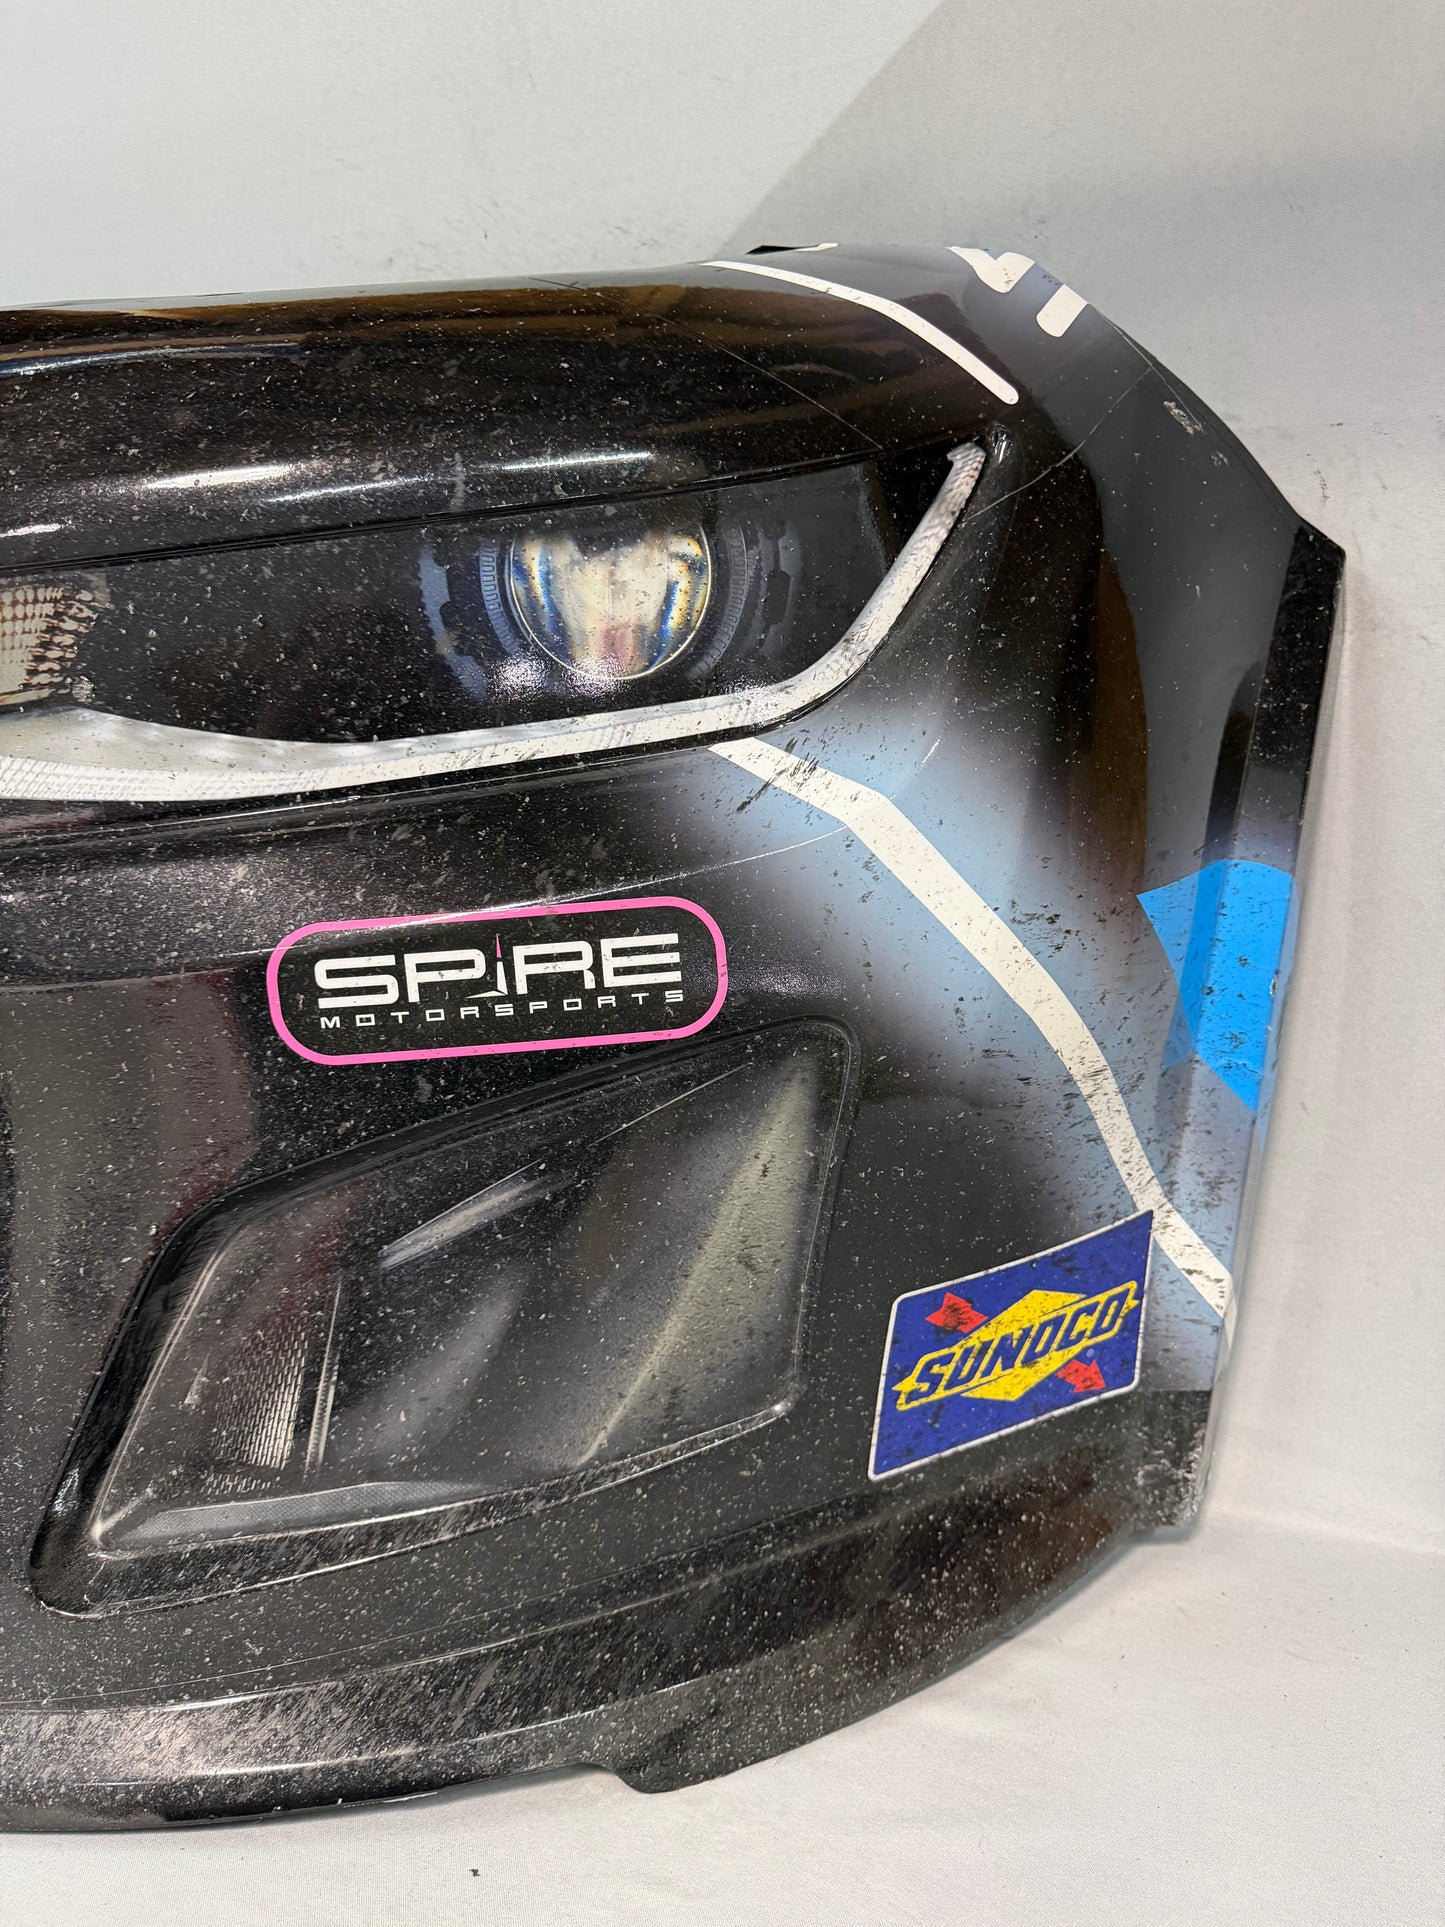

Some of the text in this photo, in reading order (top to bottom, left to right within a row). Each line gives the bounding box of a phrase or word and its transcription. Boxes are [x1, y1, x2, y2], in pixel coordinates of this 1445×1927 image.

[314, 933, 682, 1009] SPIRE
[319, 989, 685, 1030] MOTORSPORTS
[896, 1282, 1137, 1409] SUNOCO
